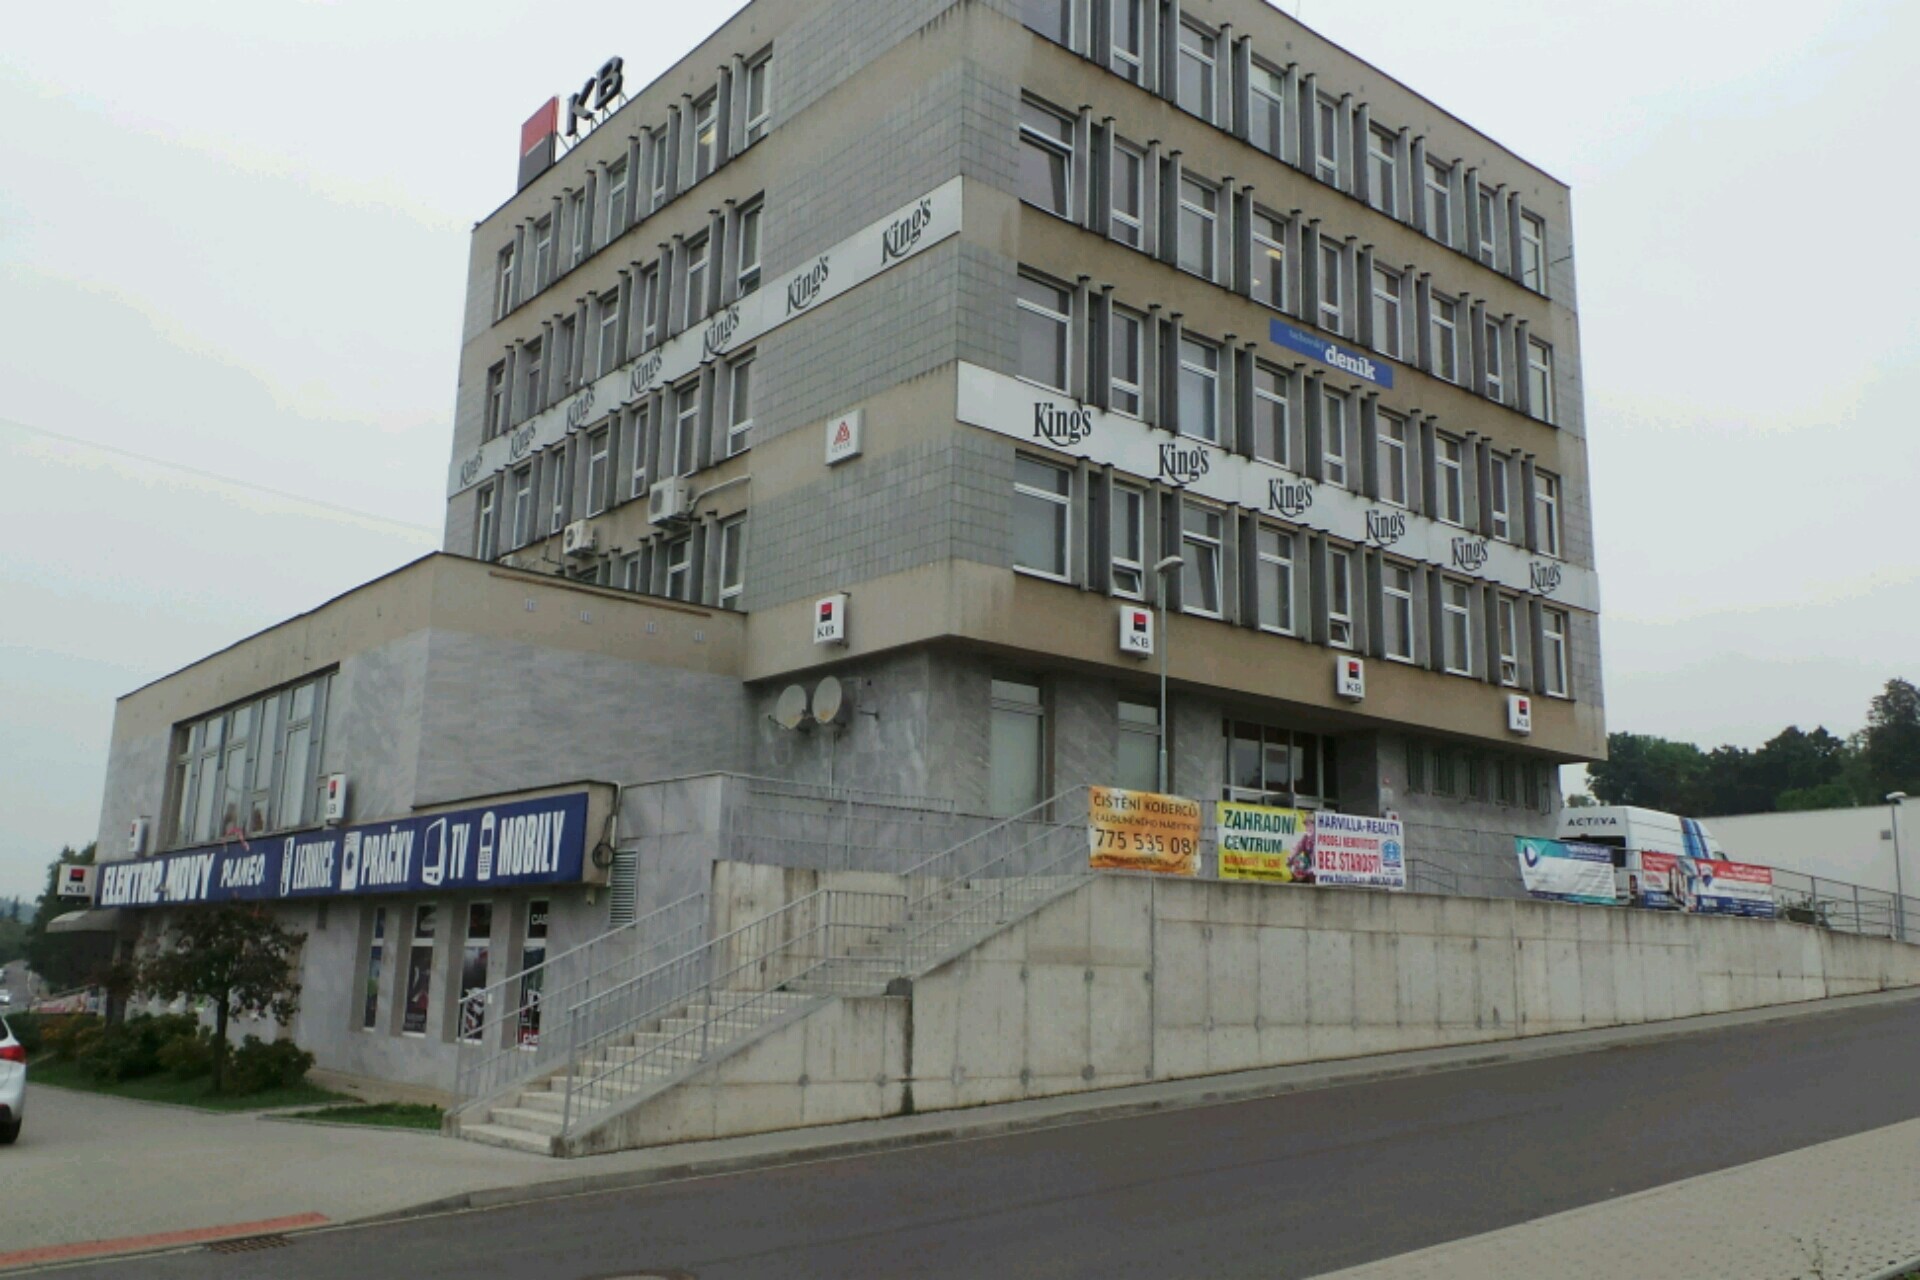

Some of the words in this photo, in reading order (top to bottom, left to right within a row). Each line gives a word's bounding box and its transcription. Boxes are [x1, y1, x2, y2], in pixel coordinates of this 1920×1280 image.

[566, 56, 624, 137] KB
[630, 347, 663, 398] King's
[704, 304, 740, 359] King's
[786, 255, 829, 316] King's
[881, 198, 931, 266] King's
[1033, 402, 1092, 447] King's
[1159, 443, 1210, 485] King's
[1268, 478, 1313, 518] King's
[1365, 509, 1405, 546] King's
[1451, 537, 1489, 572] King's
[1529, 562, 1562, 595] King's
[817, 625, 835, 639] KB
[1129, 634, 1149, 649] KB
[1345, 681, 1362, 694] KB
[1224, 809, 1297, 836] ZAHRADNÍ
[361, 824, 415, 887] PRAČKY
[450, 822, 471, 880] TV
[497, 809, 566, 877] MOBILY
[1096, 828, 1127, 850] 775
[1133, 833, 1164, 852] 535
[1224, 835, 1283, 854] CENTRUM
[1317, 850, 1336, 870] BEZ
[64, 883, 86, 894] KB
